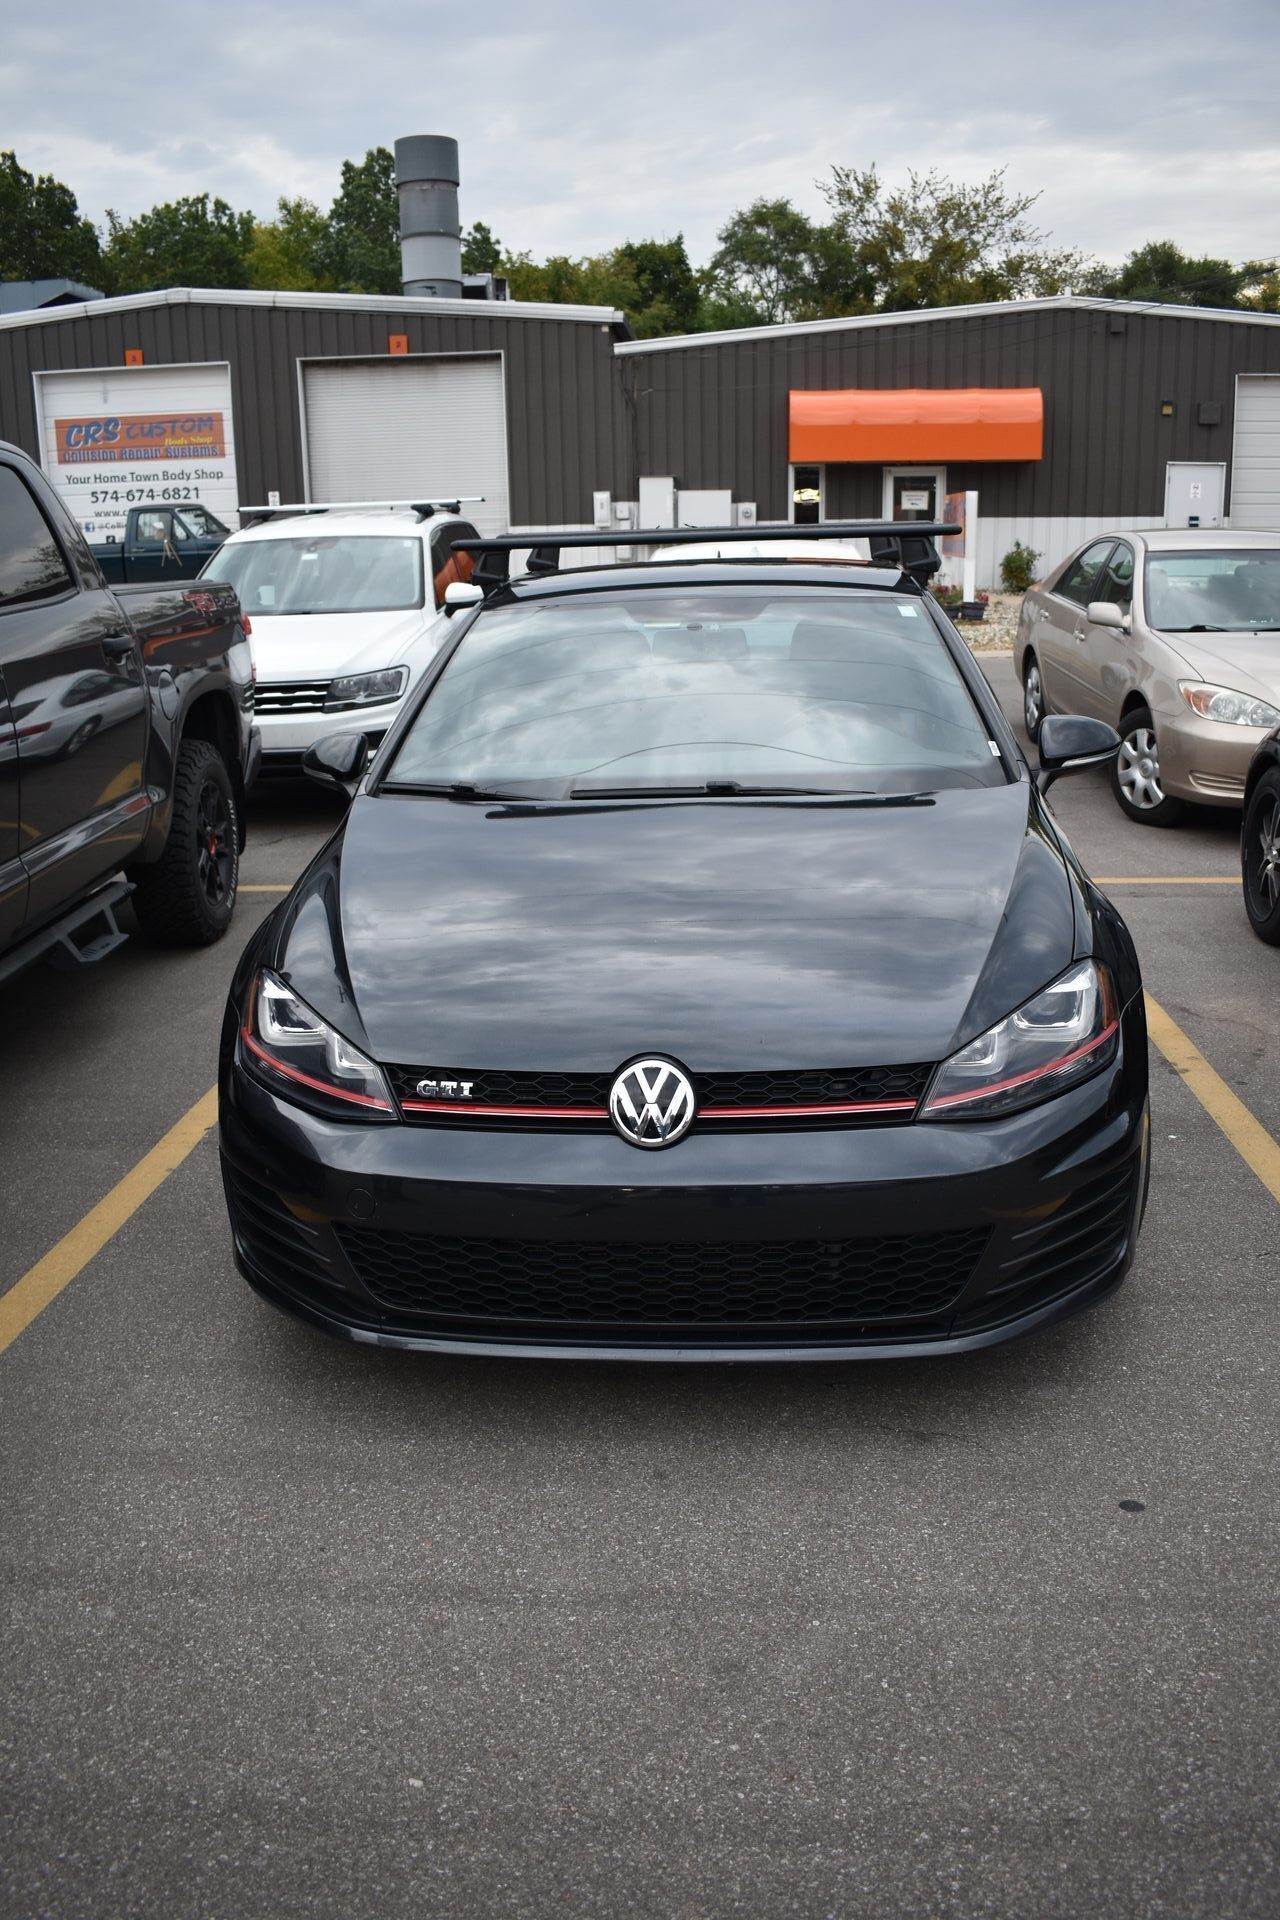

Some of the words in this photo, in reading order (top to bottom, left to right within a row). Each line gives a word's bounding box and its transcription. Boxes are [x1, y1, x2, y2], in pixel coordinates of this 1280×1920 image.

[65, 417, 122, 448] CRS
[190, 435, 214, 446] Shop
[63, 449, 118, 463] Collision
[121, 448, 162, 462] Repair
[166, 445, 219, 460] Systems
[66, 475, 91, 485] Your
[94, 473, 127, 484] Home
[129, 472, 159, 482] Town
[162, 470, 192, 482] Body
[194, 468, 224, 480] Shop
[90, 487, 200, 504] 574-674-6821
[416, 1079, 474, 1100] GTI
[609, 1058, 696, 1146] VW
